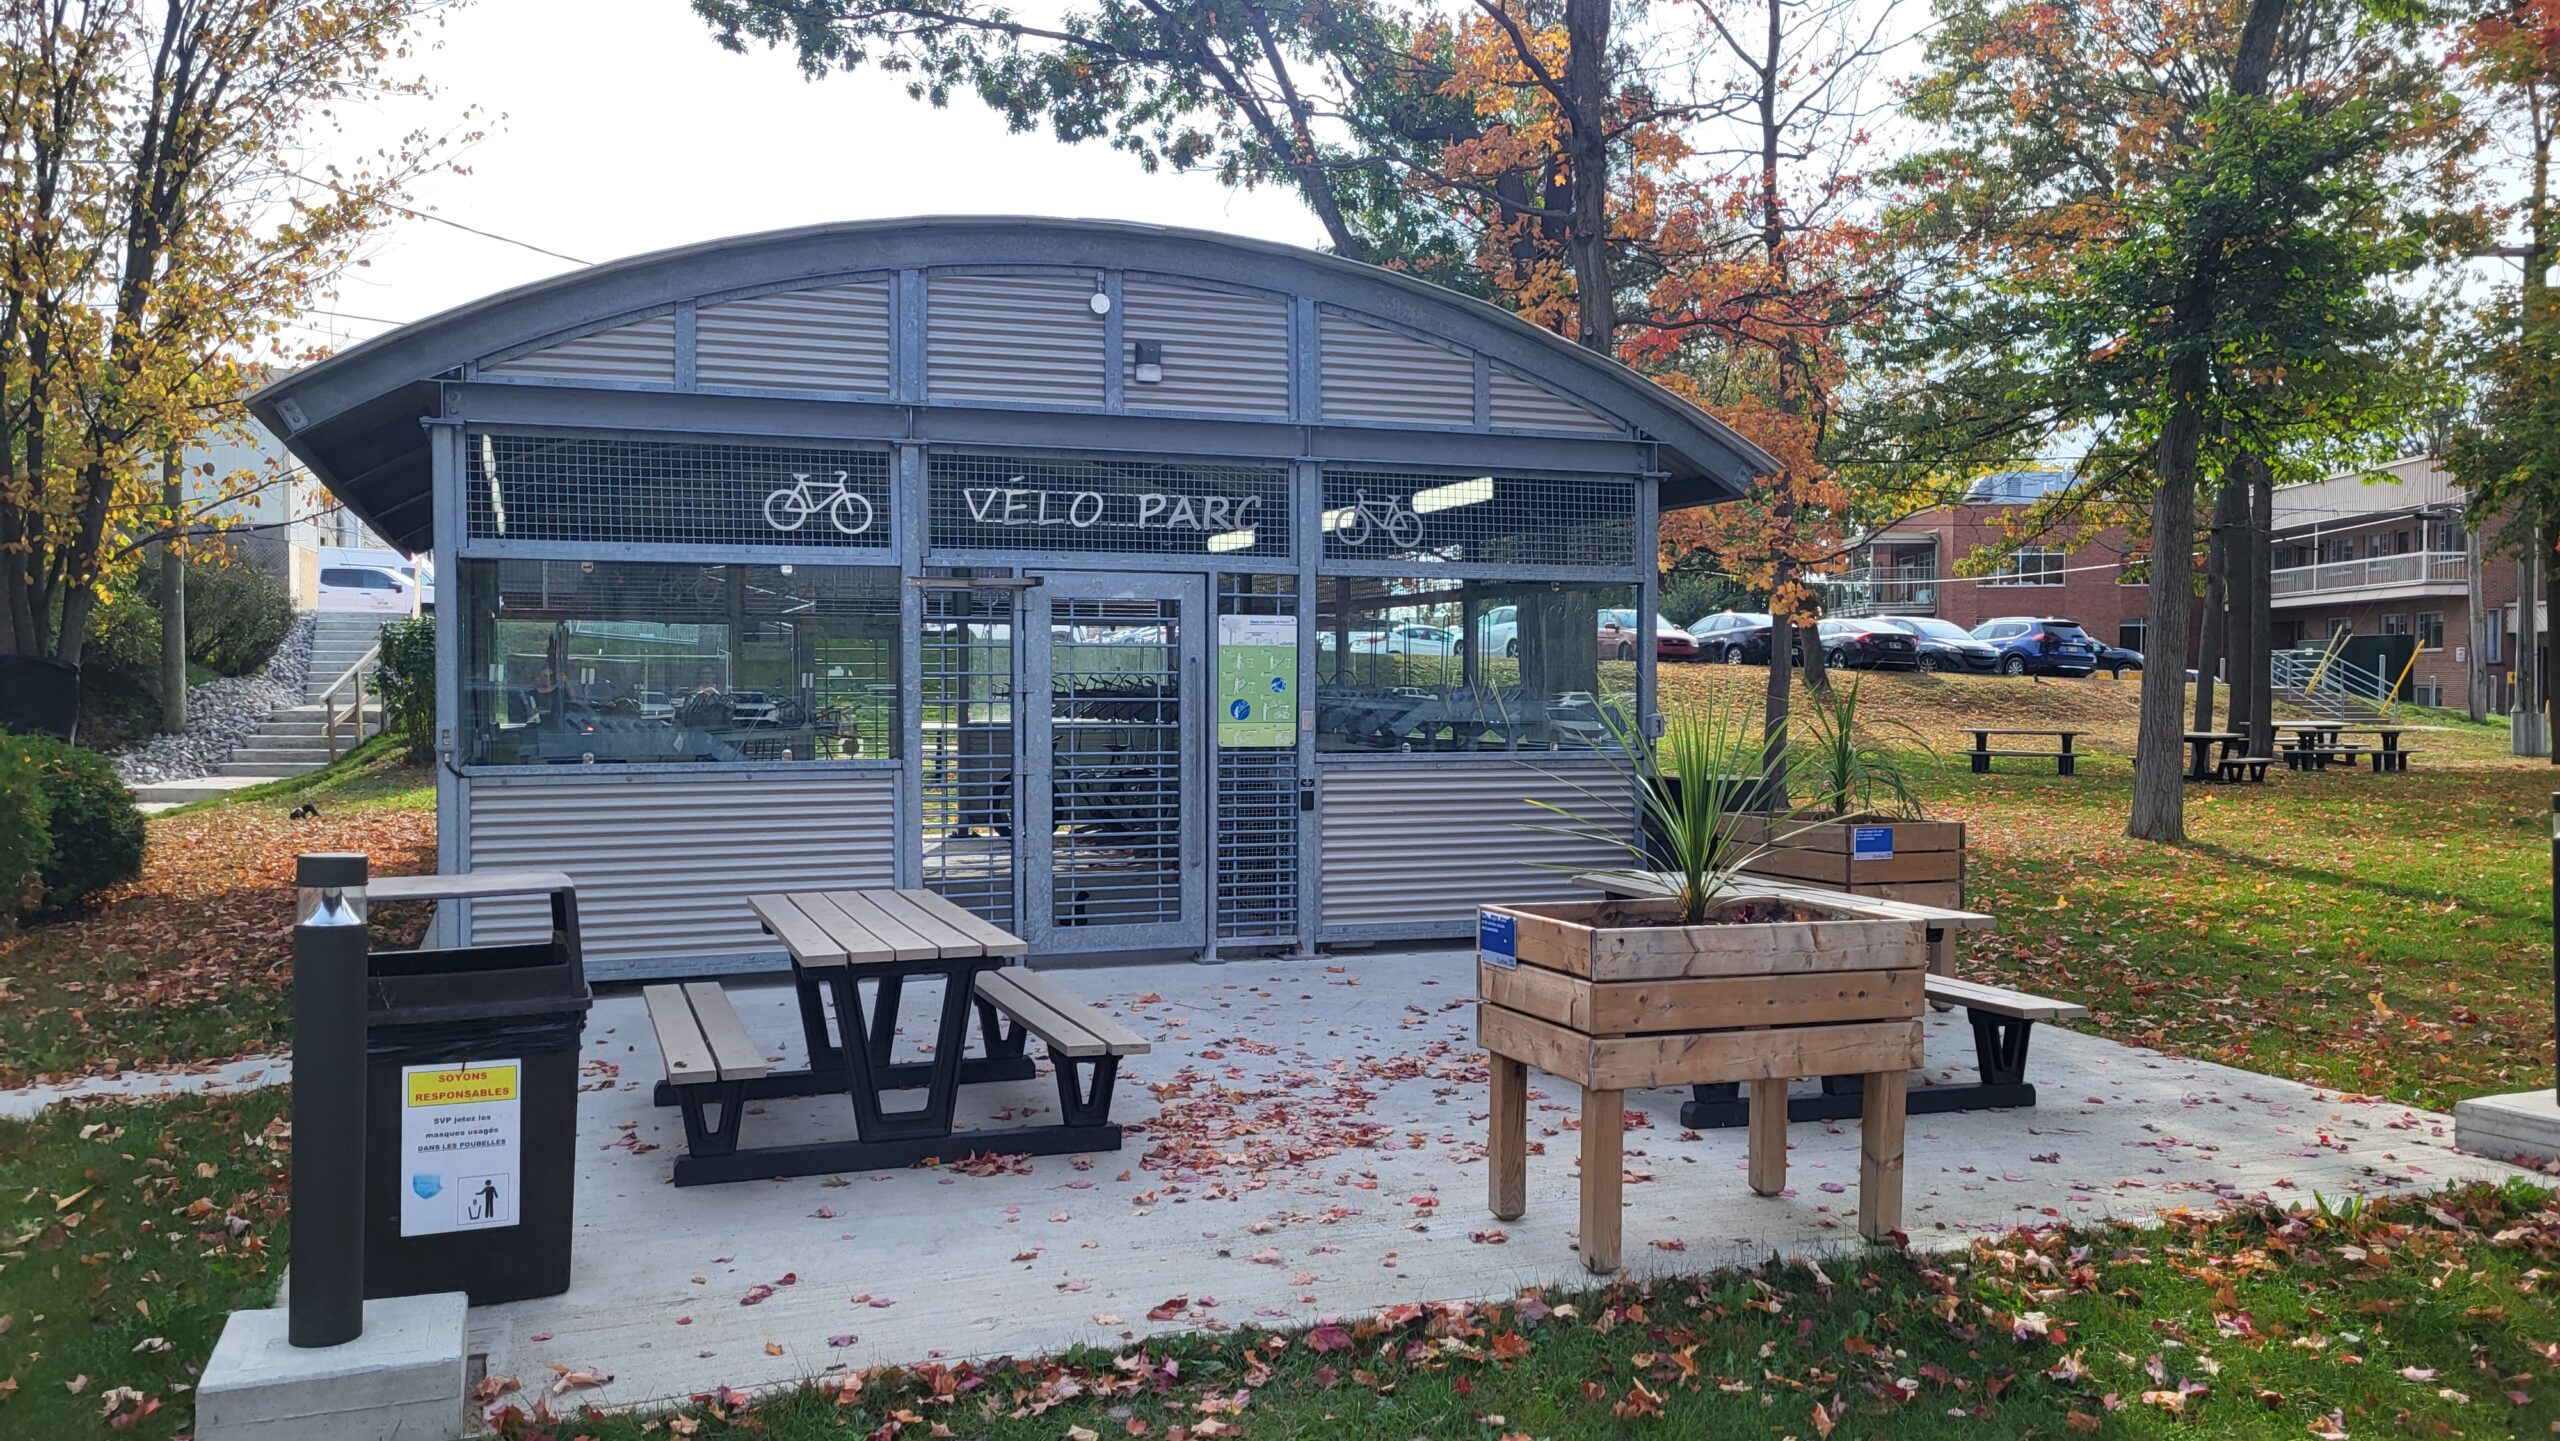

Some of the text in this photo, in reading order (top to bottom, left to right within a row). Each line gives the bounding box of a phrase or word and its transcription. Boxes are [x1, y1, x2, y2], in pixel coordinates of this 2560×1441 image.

[963, 474, 1263, 533] VÉLO PARC
[438, 1072, 488, 1083] SOYONS
[415, 1087, 509, 1101] RESPONSABLES
[433, 1114, 491, 1125] SVP jetez les
[425, 1127, 499, 1138] masques usagés
[417, 1144, 440, 1152] DANS
[459, 1139, 506, 1148] POUBELLES
